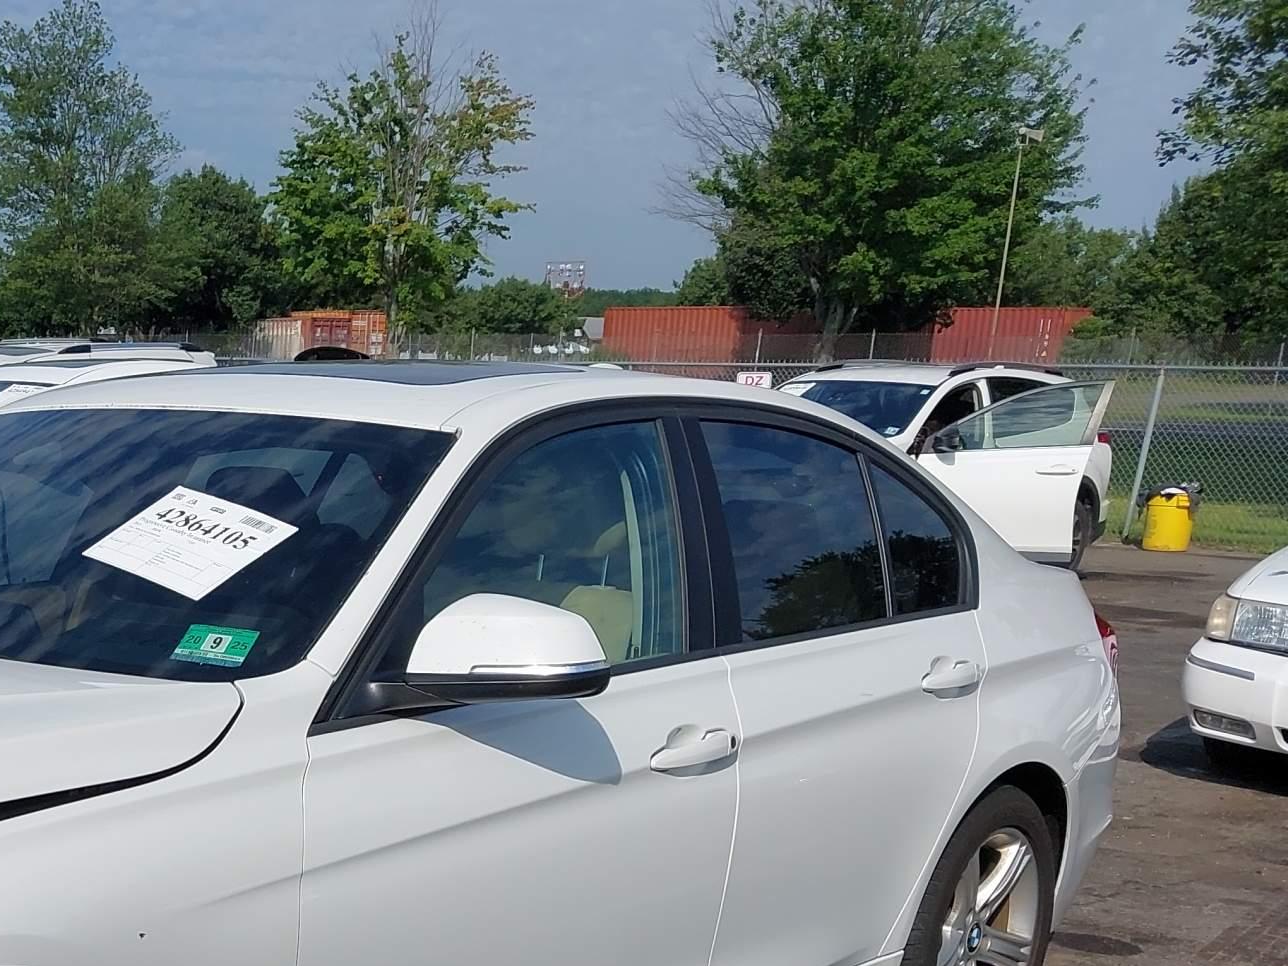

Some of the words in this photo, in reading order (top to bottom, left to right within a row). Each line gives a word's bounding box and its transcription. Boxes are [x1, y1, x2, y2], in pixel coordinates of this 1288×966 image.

[745, 375, 764, 386] DZ
[155, 507, 259, 550] 42864105
[186, 634, 202, 645] 20
[210, 636, 223, 650] 9
[231, 641, 248, 651] 25
